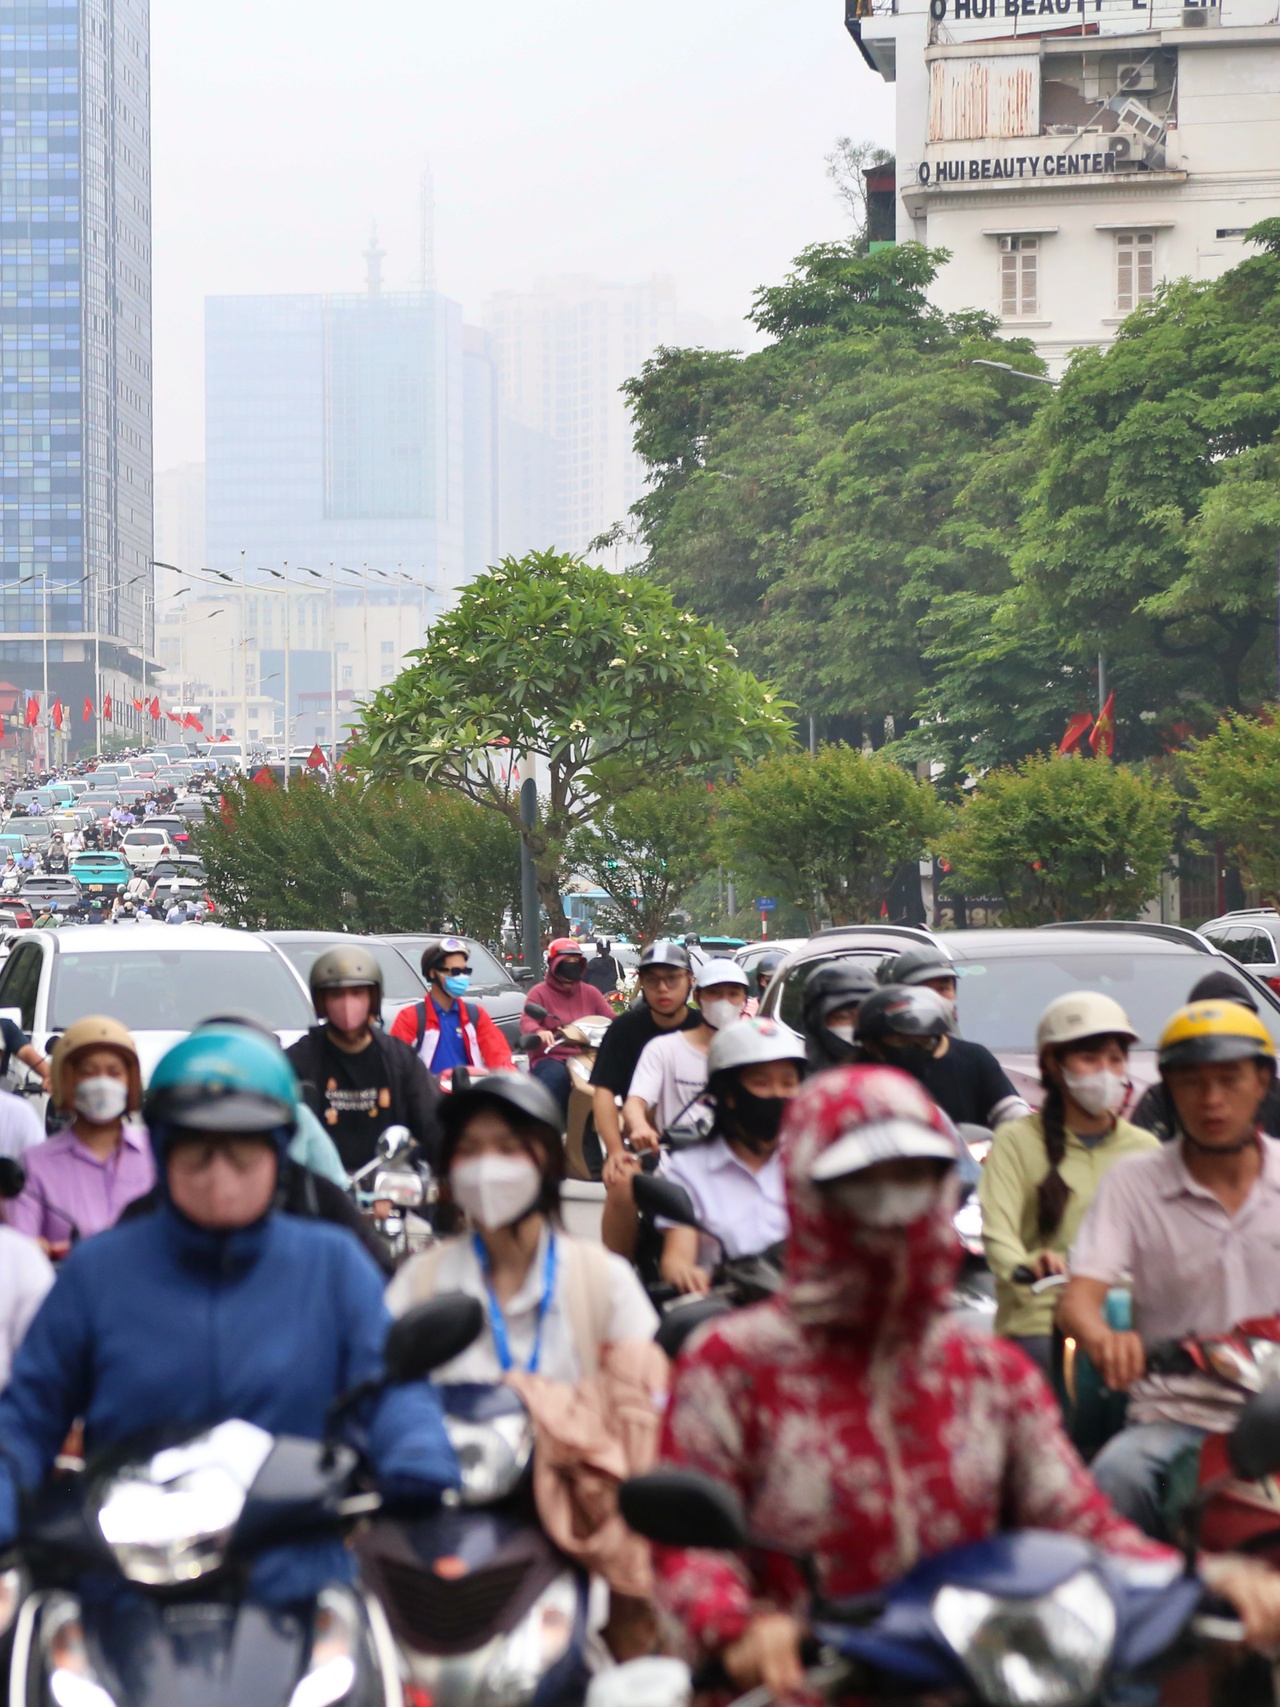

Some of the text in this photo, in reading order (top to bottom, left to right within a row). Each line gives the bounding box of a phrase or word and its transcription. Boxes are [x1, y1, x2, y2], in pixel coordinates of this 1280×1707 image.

[930, 0, 947, 21] O
[954, 0, 995, 19] HUI
[919, 152, 1115, 184] O HUI BEAUTY CENTER
